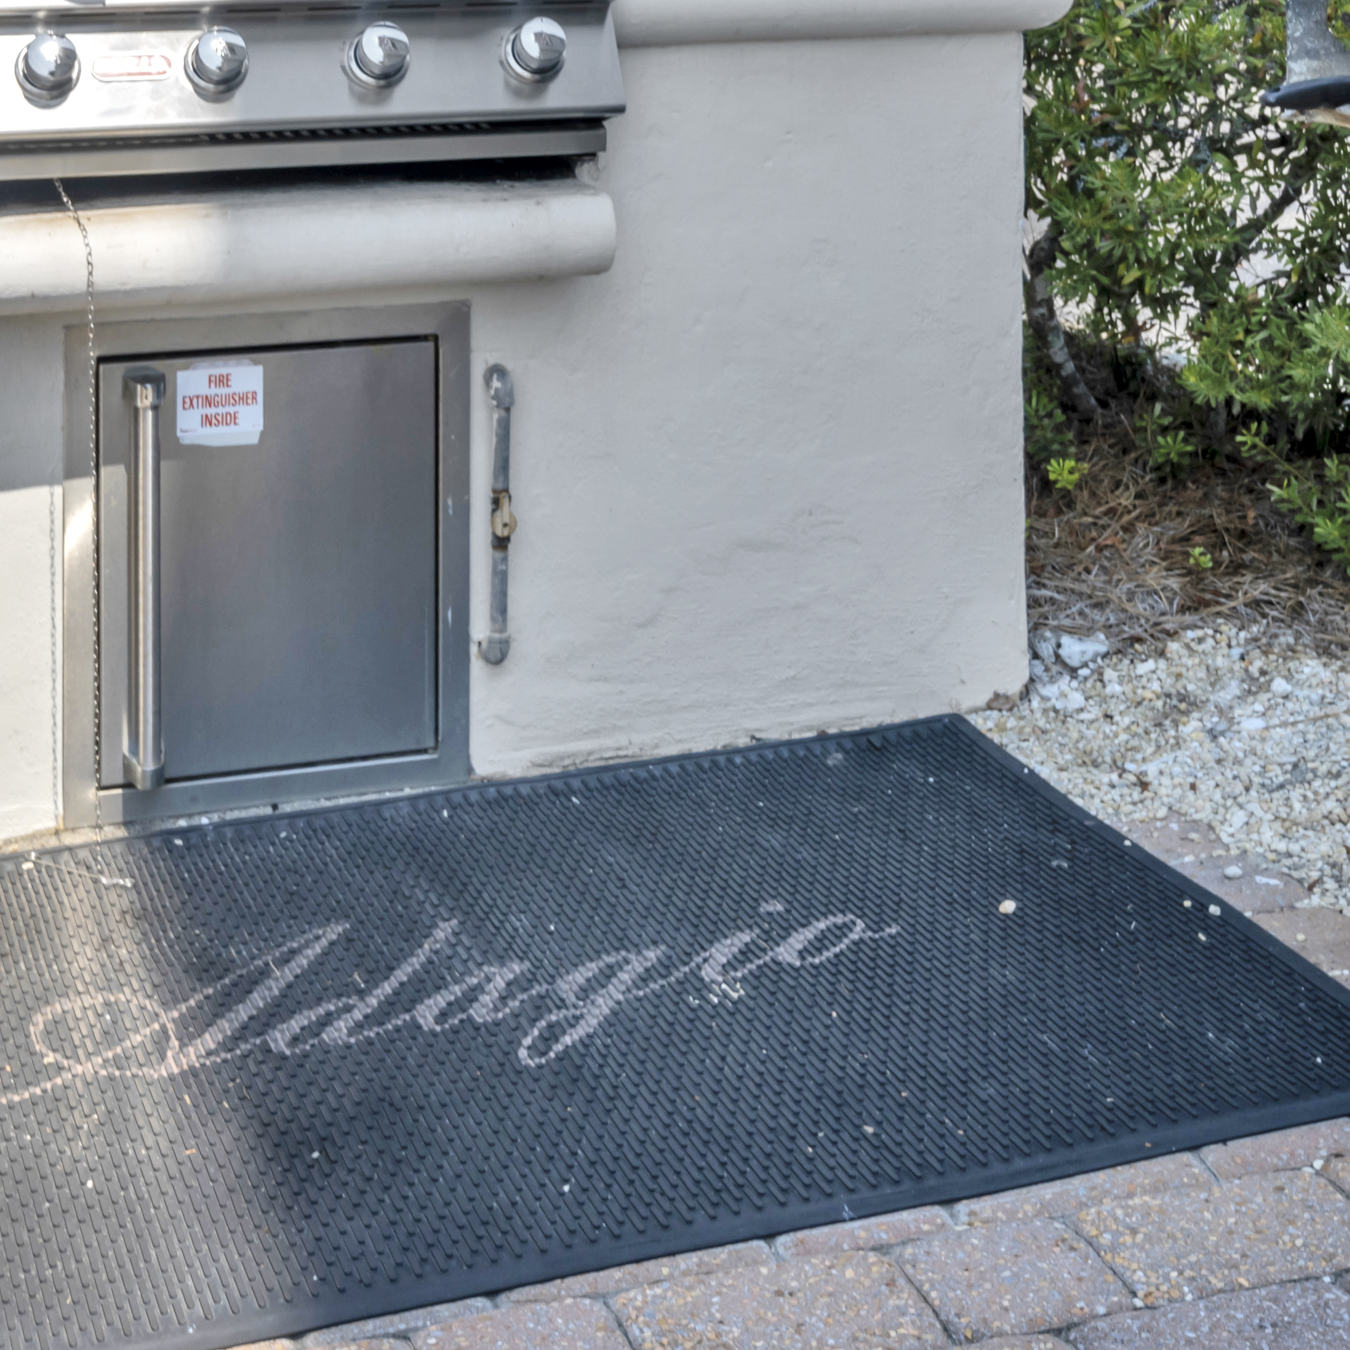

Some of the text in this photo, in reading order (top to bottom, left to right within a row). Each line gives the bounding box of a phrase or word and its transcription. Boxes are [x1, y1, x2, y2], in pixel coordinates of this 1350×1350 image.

[208, 373, 232, 389] FIRE
[182, 391, 258, 410] EXTINGUISHER
[201, 411, 239, 428] INSIDE
